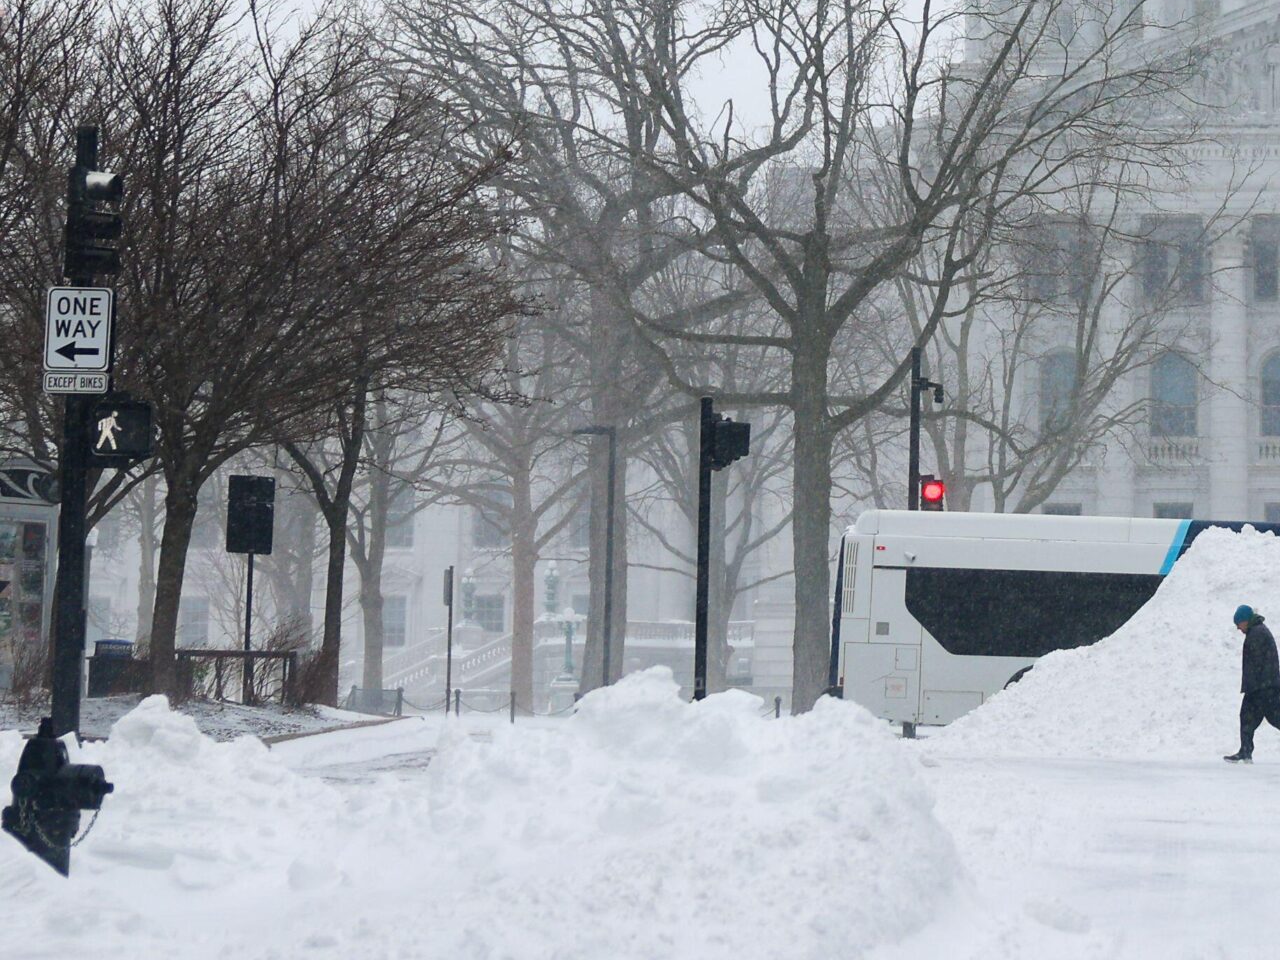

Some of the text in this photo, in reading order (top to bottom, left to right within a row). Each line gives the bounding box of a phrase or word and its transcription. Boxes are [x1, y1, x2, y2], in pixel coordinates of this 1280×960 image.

[57, 296, 101, 316] ONE
[55, 319, 101, 338] WAY
[47, 376, 103, 389] EXCEPT BIKES
